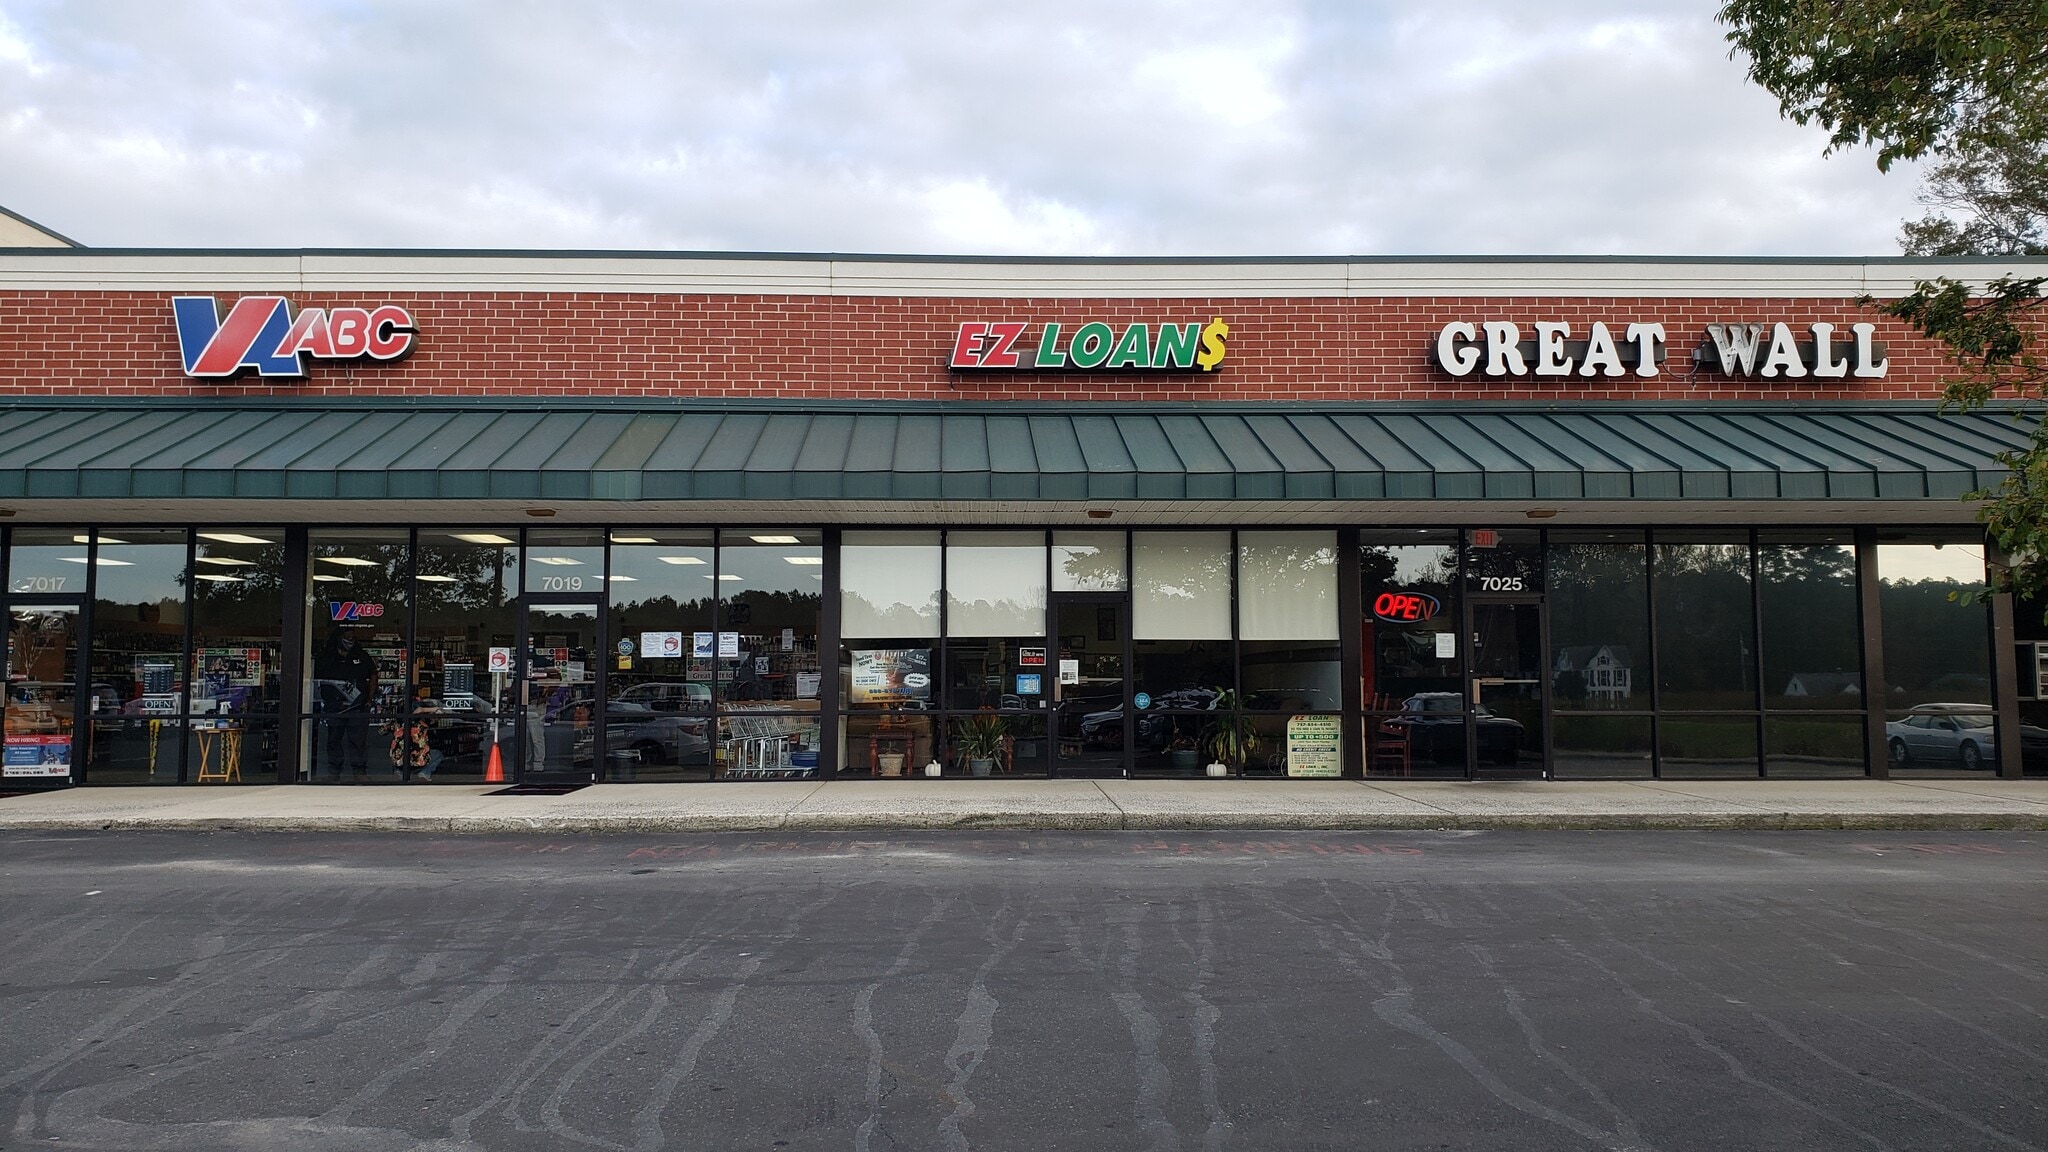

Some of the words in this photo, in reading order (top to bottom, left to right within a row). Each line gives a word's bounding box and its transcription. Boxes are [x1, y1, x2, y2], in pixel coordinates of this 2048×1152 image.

[271, 305, 414, 360] ABC
[950, 322, 1028, 368] EZ
[1035, 317, 1230, 371] LOAN$
[1437, 321, 1666, 377] GREAT
[1706, 321, 1889, 378] WALL
[1475, 530, 1494, 545] EXIT
[27, 577, 66, 591] 7017
[542, 576, 583, 590] 7019
[1480, 577, 1523, 591] 7025
[352, 603, 384, 616] ABC
[1374, 593, 1434, 621] OPEN
